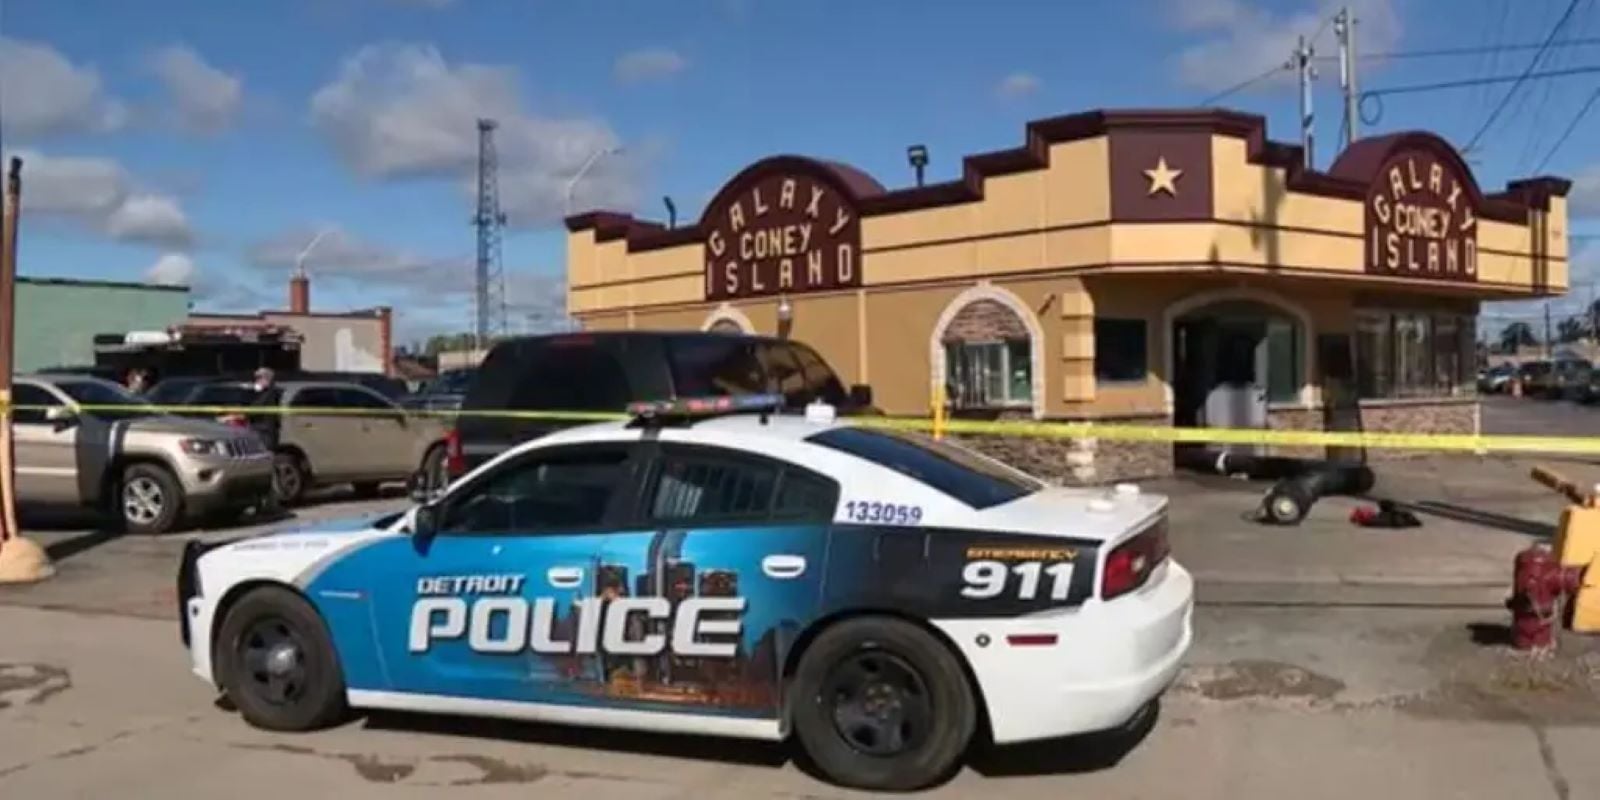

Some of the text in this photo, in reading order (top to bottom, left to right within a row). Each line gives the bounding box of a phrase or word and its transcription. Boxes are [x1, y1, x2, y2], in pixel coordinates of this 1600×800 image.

[1373, 158, 1475, 231] GALAXY
[709, 178, 850, 257] GALAXY
[1395, 202, 1451, 240] CONEY
[740, 223, 812, 261] CONEY
[1372, 224, 1476, 275] ISLAND
[707, 243, 852, 295] ISLAND
[845, 501, 923, 525] 133059
[966, 547, 1078, 561] EMERGENCY
[417, 574, 523, 594] DETROIT
[960, 560, 1075, 600] 911
[409, 596, 746, 656] POLICE
